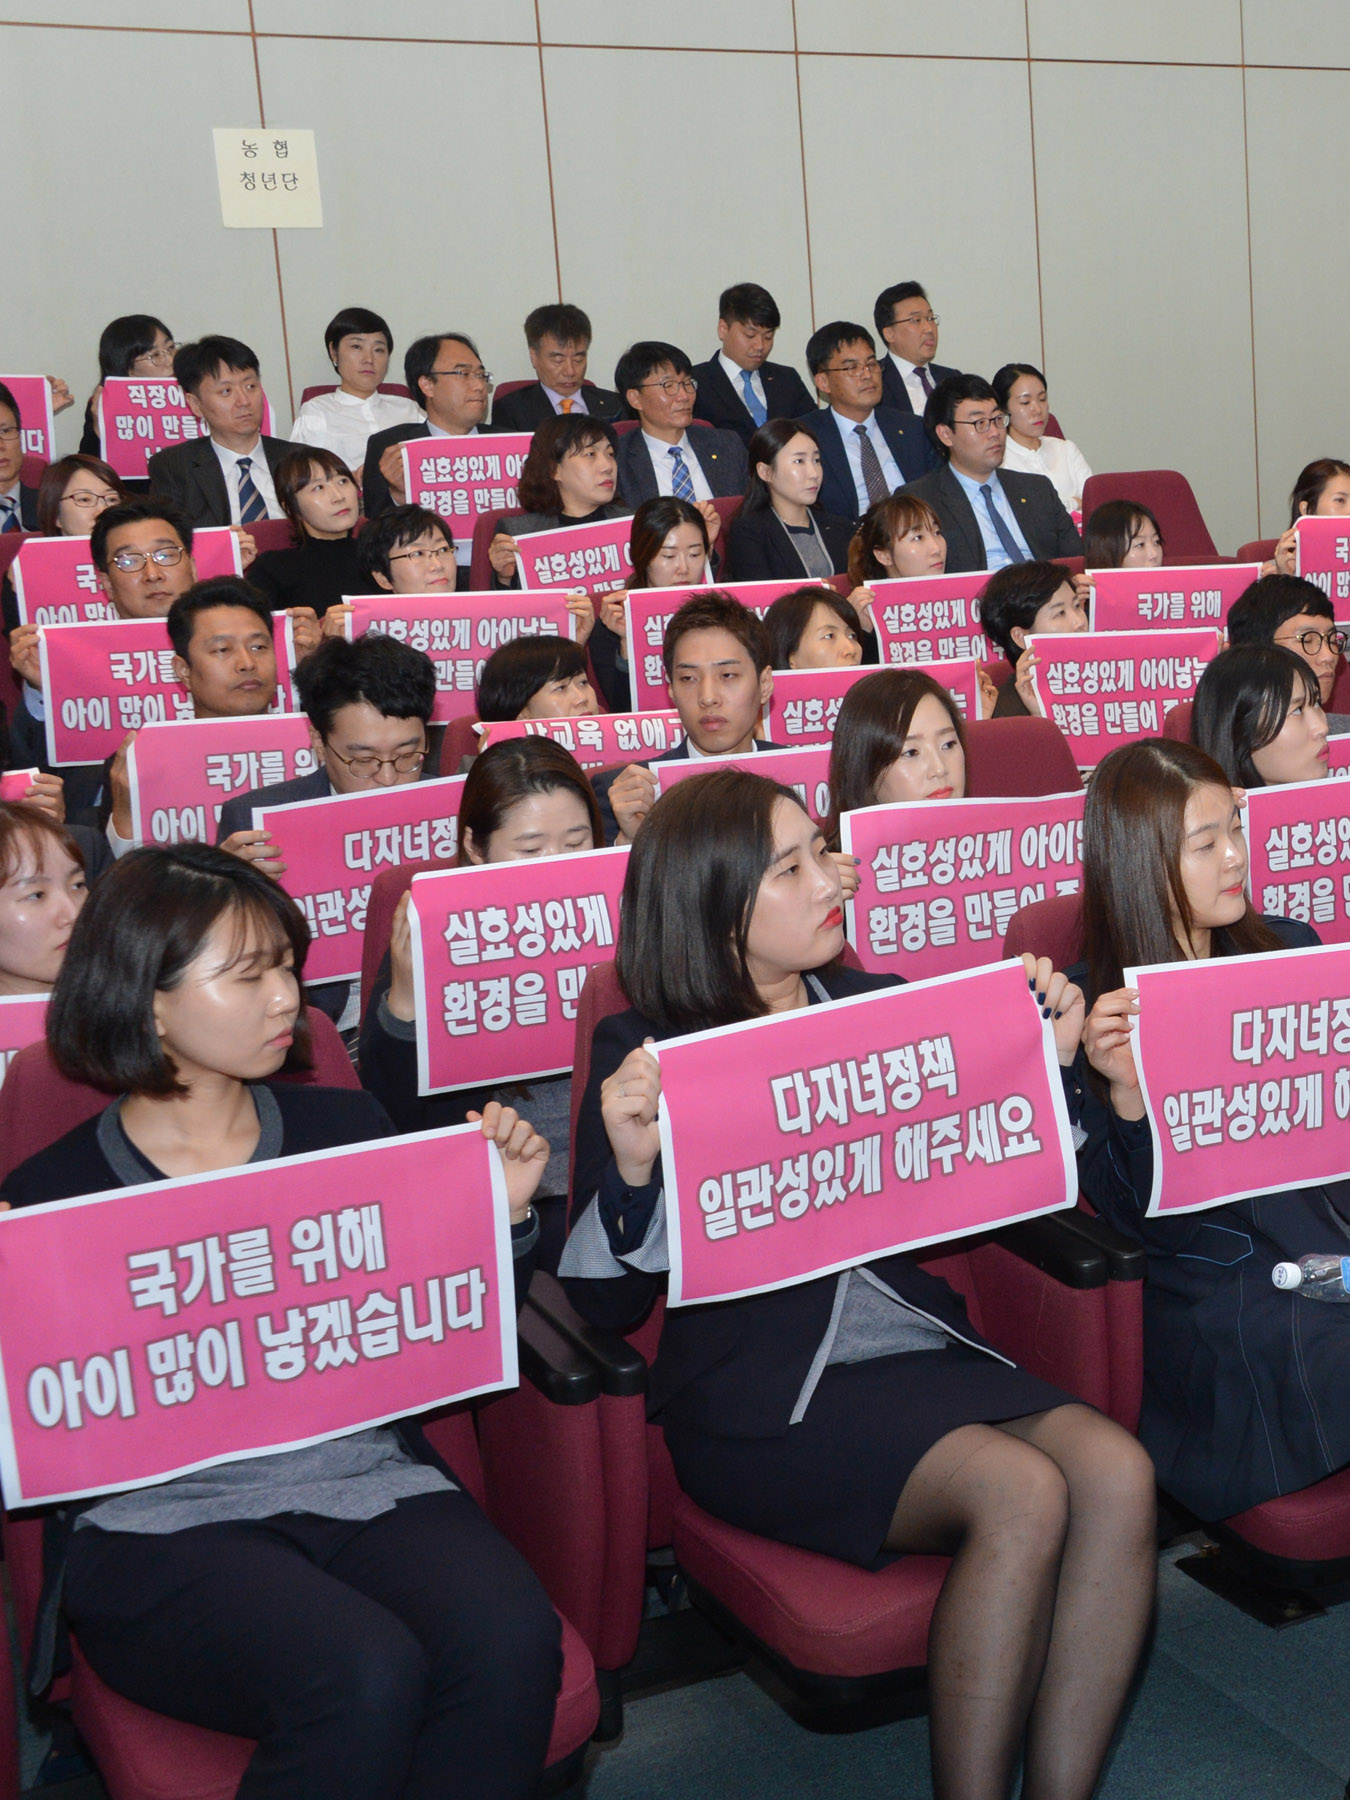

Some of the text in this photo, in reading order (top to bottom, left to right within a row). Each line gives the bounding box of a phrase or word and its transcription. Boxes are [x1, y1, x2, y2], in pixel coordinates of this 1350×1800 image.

[240, 171, 299, 191] 청년단
[115, 415, 154, 441] 많이
[419, 454, 502, 484] 실효성있게
[534, 543, 621, 585] 실효성있게
[882, 598, 967, 634] 실효성있게
[1137, 590, 1222, 621] 국가를 위해
[109, 650, 181, 686] 국가를
[1046, 658, 1135, 695] 실효성있게
[61, 696, 111, 731] 아이
[118, 693, 166, 729] 많이
[1051, 702, 1099, 737] 환경을
[1103, 699, 1159, 735] 만들어
[206, 751, 285, 793] 국가를
[152, 806, 207, 846] 아이
[344, 815, 458, 872] 다자녀정
[871, 828, 1014, 893] 실효성있게
[1262, 877, 1336, 924] 환경을
[444, 893, 614, 966] 실효성있게
[868, 896, 957, 955] 환경을
[443, 972, 547, 1036] 환경을
[769, 1034, 958, 1135] 다자녀정책
[1163, 1072, 1323, 1153] 일관성있게
[700, 1094, 1041, 1241] 일관성있게 해주세요
[128, 1202, 388, 1317] 국가를 위해
[27, 1266, 487, 1430] 아이 많이 낳겠습니다
